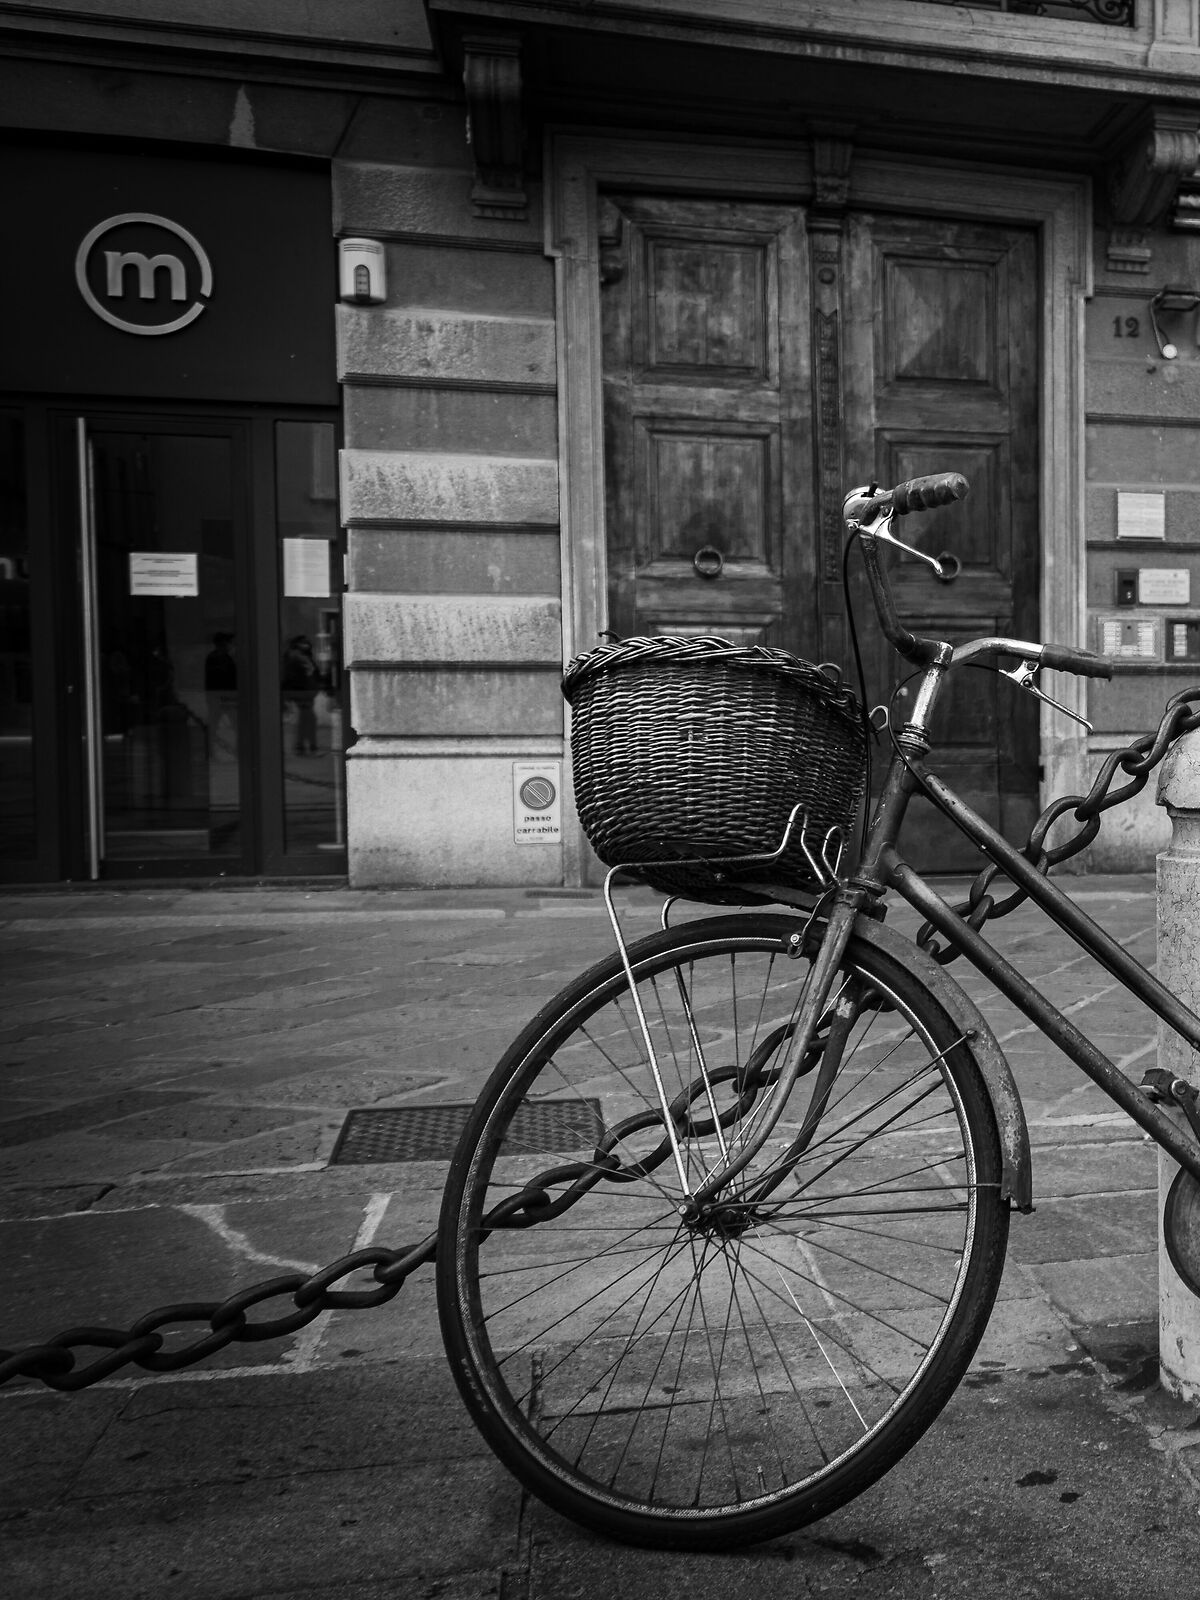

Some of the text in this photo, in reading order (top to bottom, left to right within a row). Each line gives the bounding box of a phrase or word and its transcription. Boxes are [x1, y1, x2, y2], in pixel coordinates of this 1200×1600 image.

[104, 251, 187, 300] m
[1112, 315, 1139, 338] 12
[516, 826, 559, 834] carrabile
